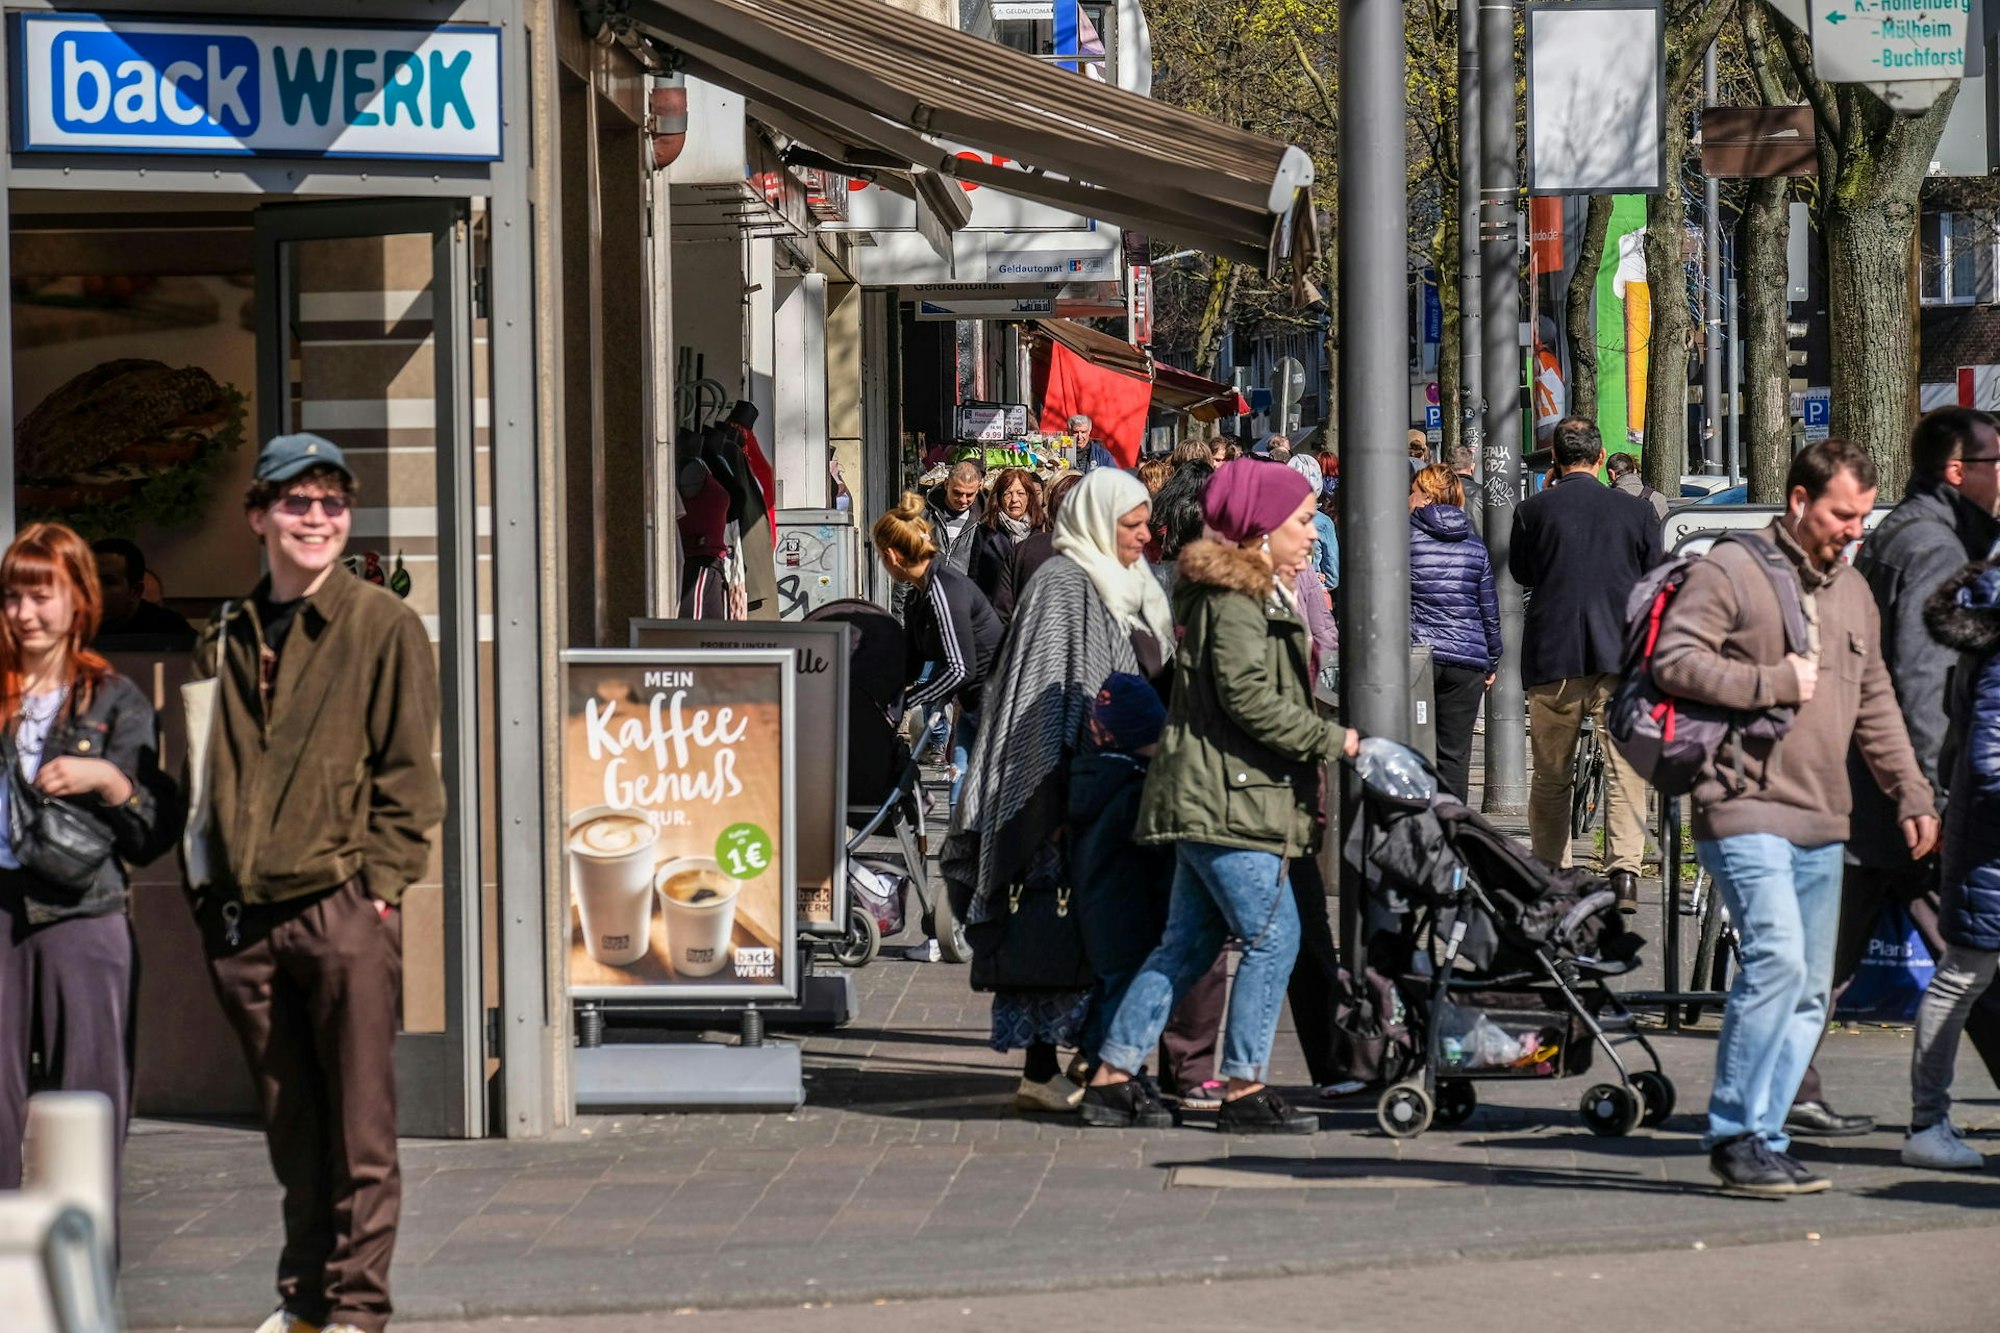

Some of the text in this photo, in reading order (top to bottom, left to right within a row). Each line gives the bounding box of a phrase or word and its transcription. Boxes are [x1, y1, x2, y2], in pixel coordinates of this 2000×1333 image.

[63, 39, 476, 131] back WERK
[998, 264, 1063, 274] Geldautomat
[1809, 402, 1823, 423] P
[644, 671, 694, 688] MEIN
[603, 748, 743, 811] Genuß
[727, 841, 767, 875] 1€
[737, 950, 772, 963] back
[735, 965, 775, 978] WERK
